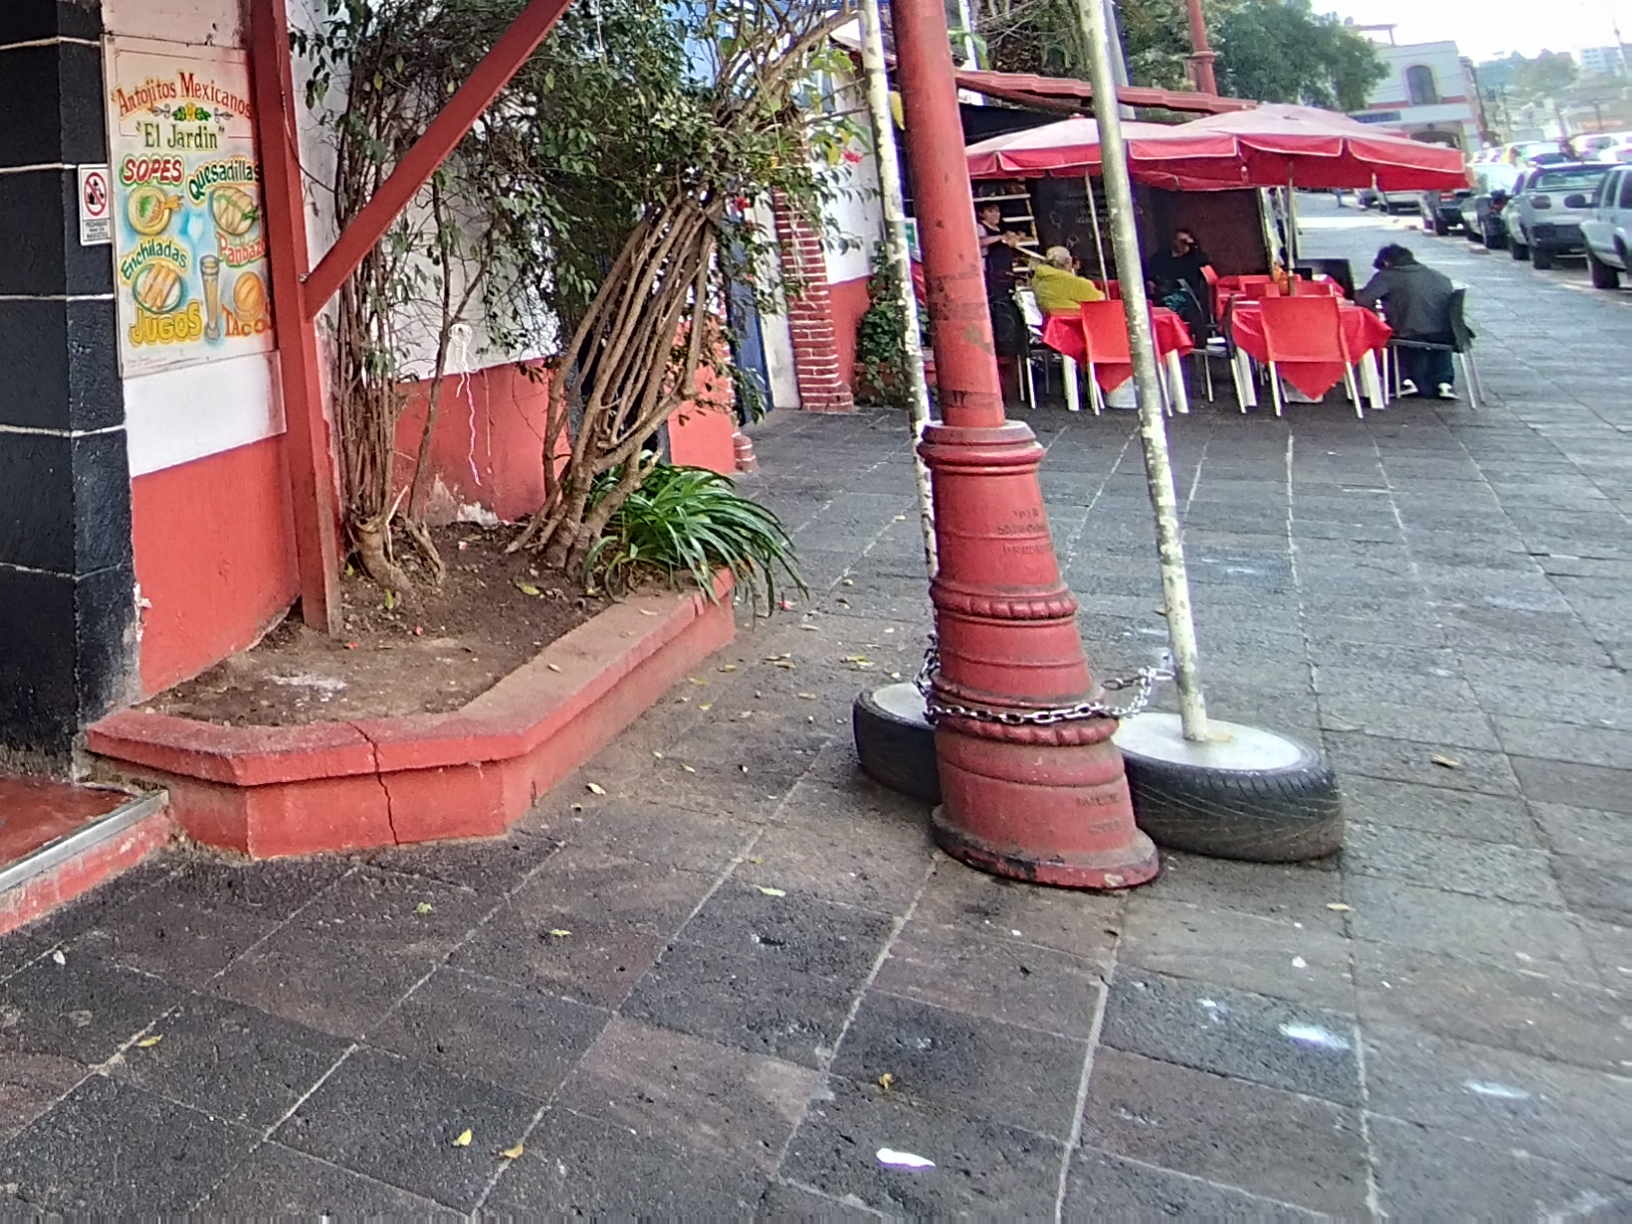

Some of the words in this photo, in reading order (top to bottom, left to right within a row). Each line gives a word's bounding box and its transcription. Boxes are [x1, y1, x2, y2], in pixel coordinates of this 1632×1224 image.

[179, 72, 252, 119] Mexicanos
[123, 158, 183, 183] SOPES
[120, 238, 187, 281] Enchiladas
[129, 301, 202, 344] JUGOS
